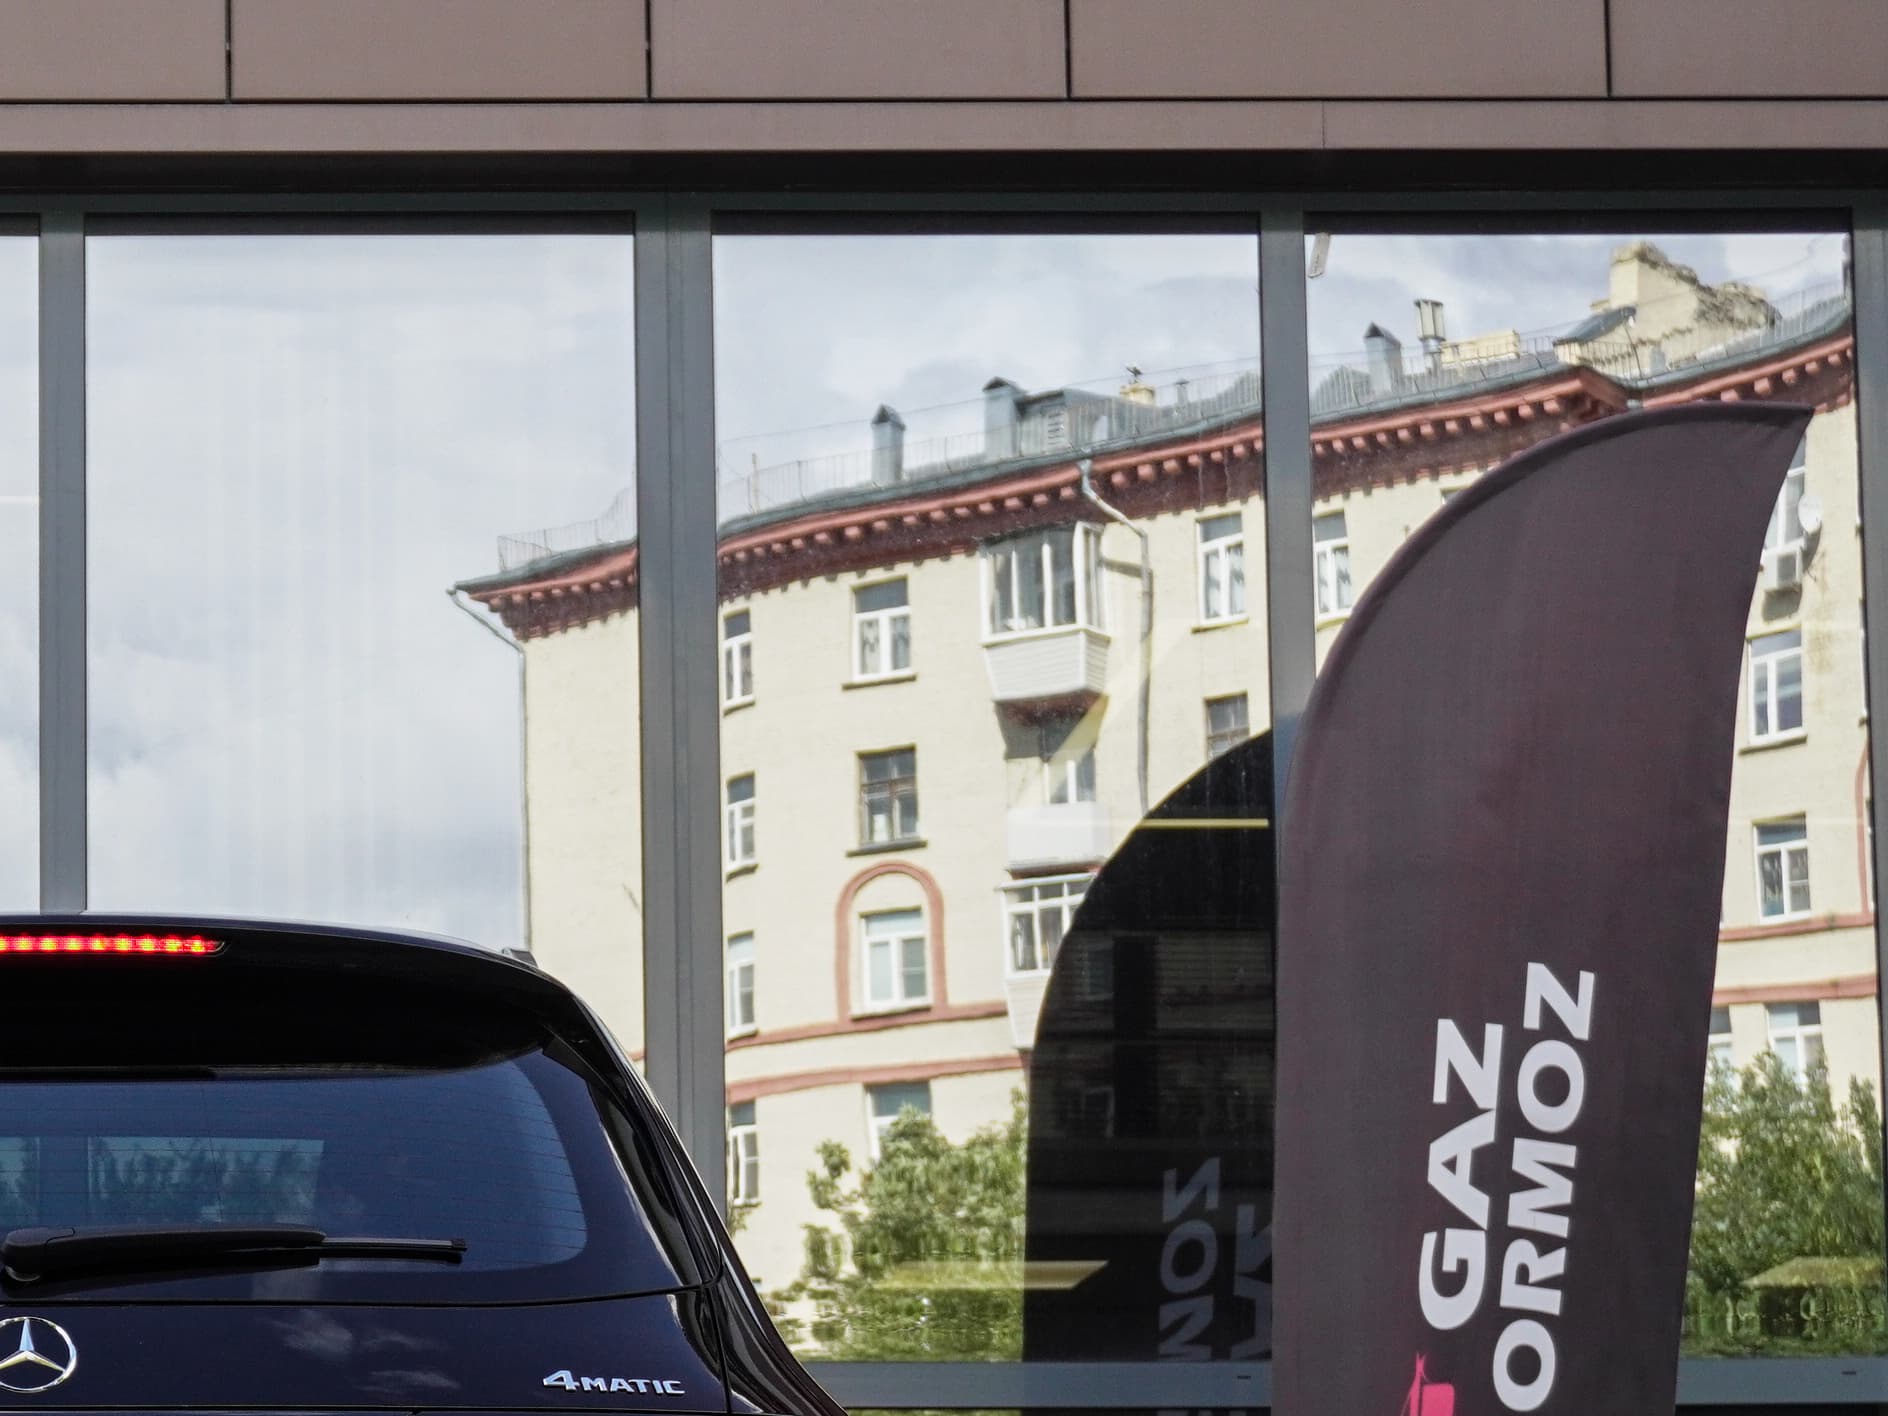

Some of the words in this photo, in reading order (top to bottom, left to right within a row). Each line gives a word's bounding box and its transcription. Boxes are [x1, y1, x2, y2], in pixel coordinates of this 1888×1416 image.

[1418, 1018, 1504, 1330] GAZ
[1492, 962, 1595, 1411] ORMOZ
[542, 1369, 686, 1395] 4MATIC
